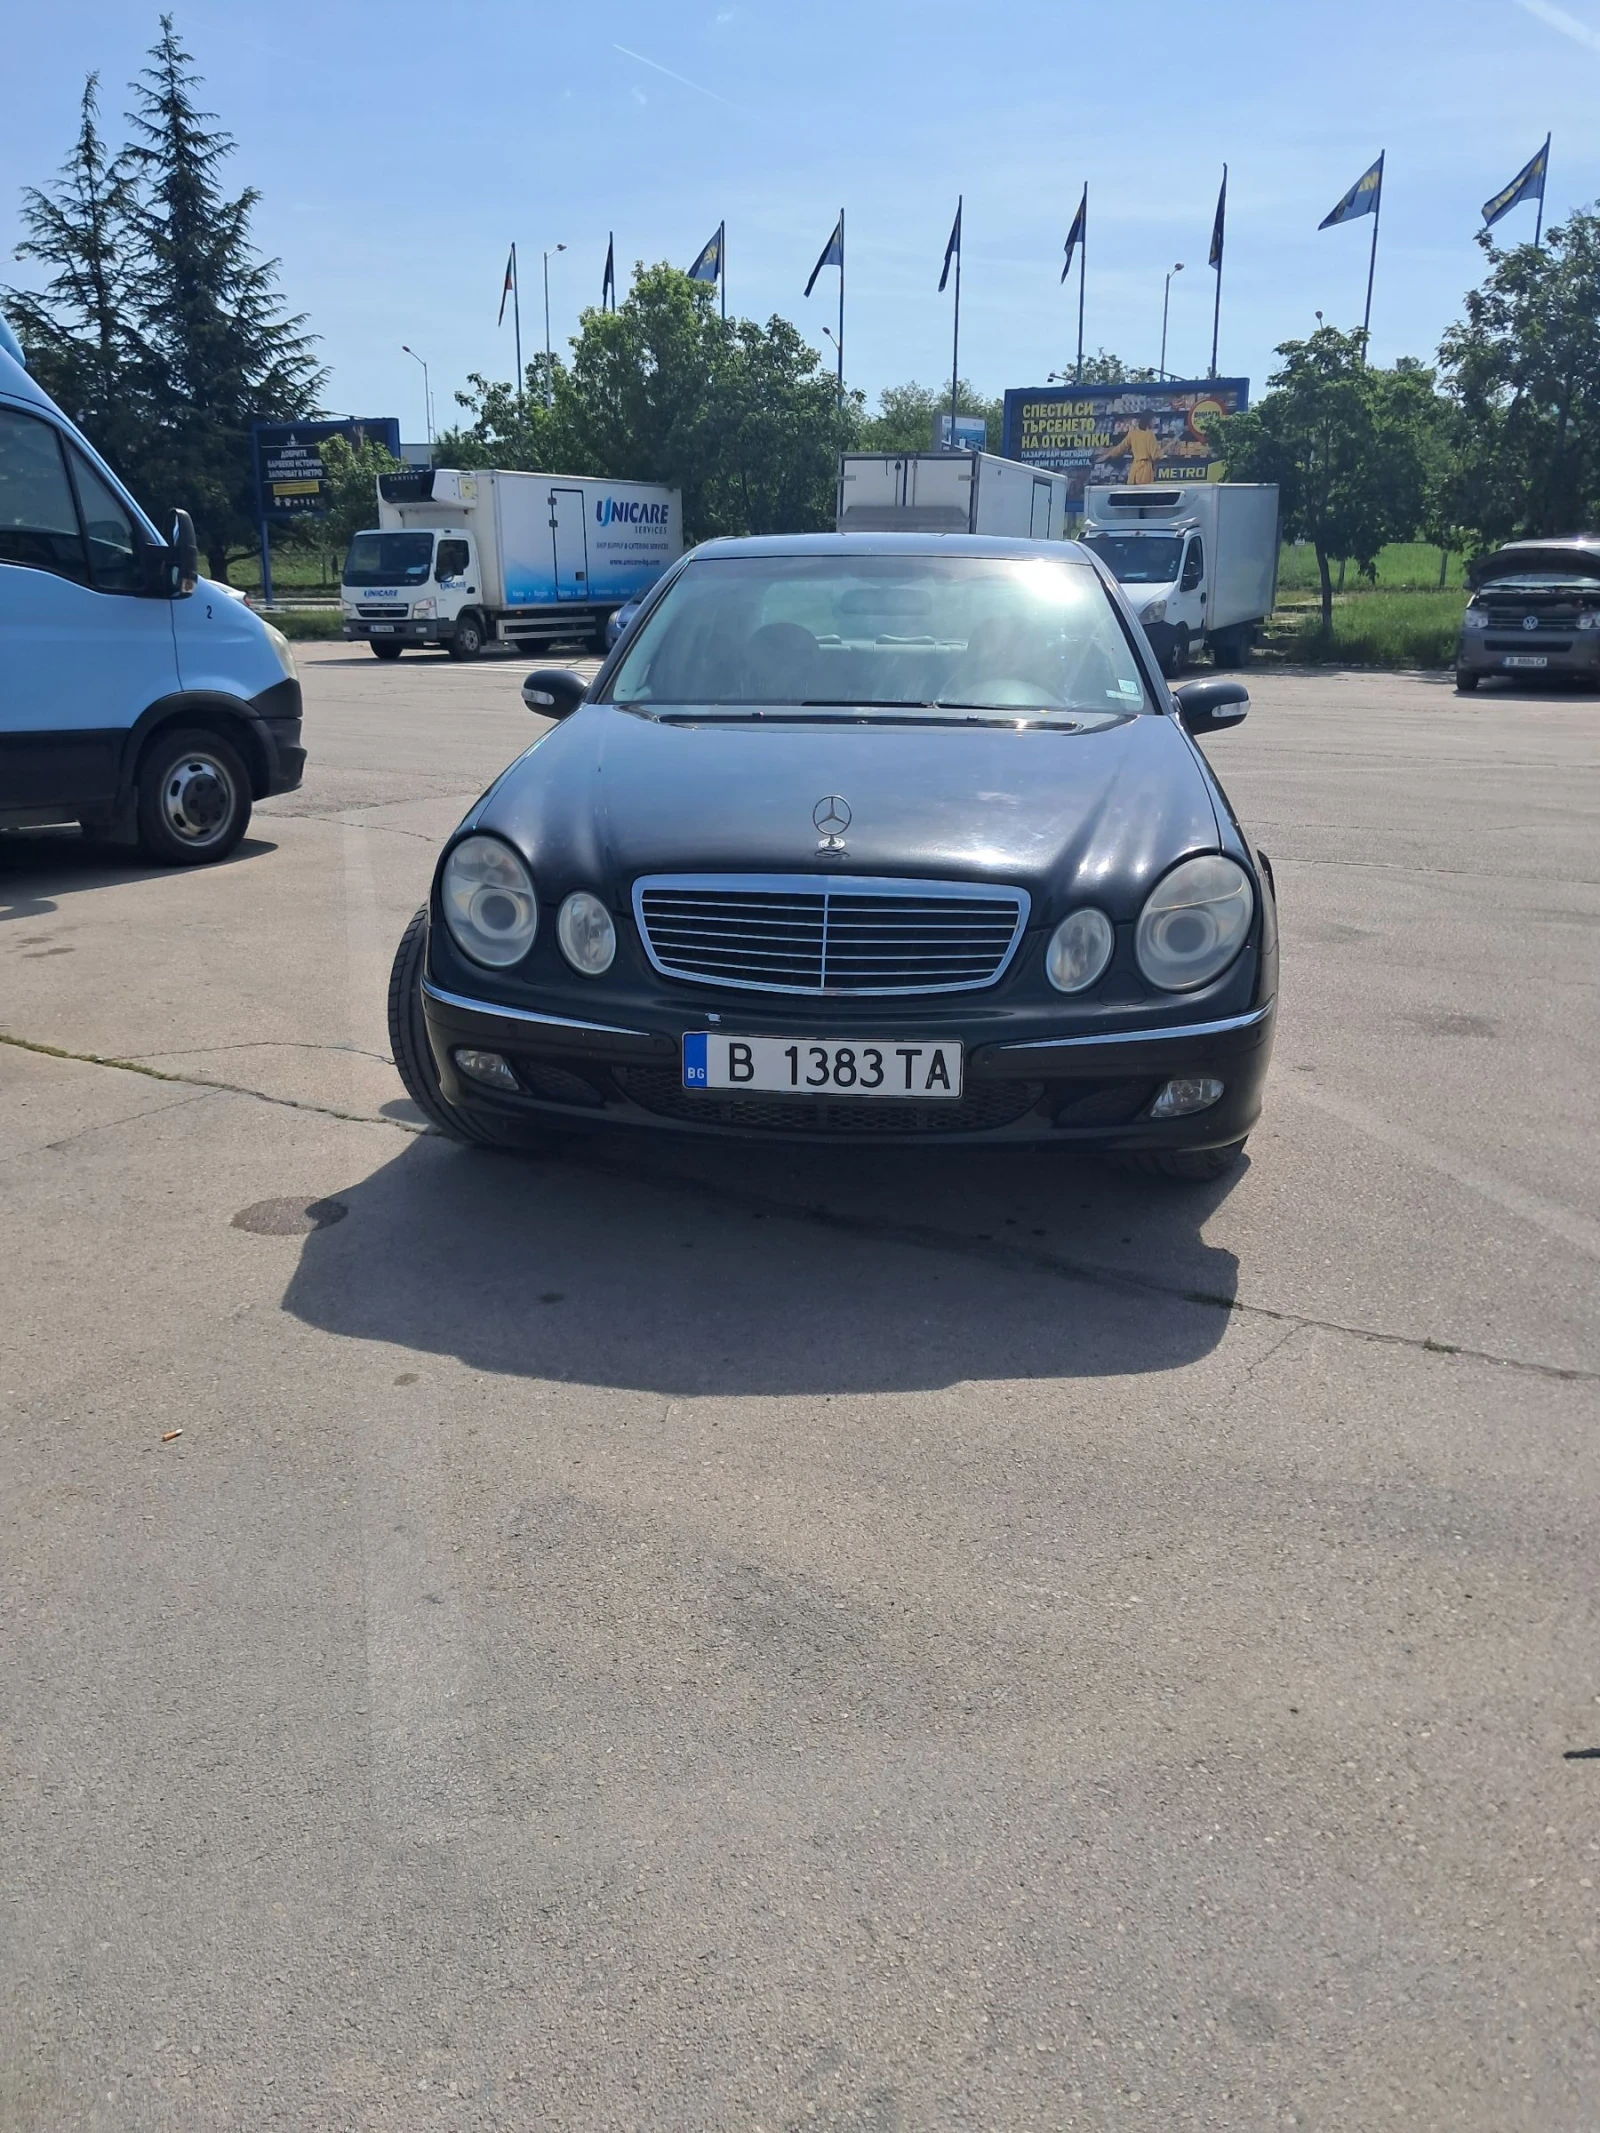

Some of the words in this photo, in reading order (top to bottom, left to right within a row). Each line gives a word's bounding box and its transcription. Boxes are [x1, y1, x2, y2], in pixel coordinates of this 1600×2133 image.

[1022, 402, 1072, 418] СПЕСТИ
[1075, 402, 1094, 416] СИ
[1022, 417, 1096, 433] ТЪРСЕНЕТО
[1021, 435, 1039, 448] НА
[1041, 433, 1113, 448] ОТСТЪПКИ.
[1158, 467, 1206, 478] METRO
[596, 496, 669, 527] UNICARE
[634, 525, 667, 535] SERVICES
[440, 581, 467, 591] UNICARE
[364, 589, 398, 599] UNICARE
[206, 605, 213, 620] 2
[687, 1067, 705, 1079] BG
[729, 1042, 755, 1082] B
[784, 1045, 885, 1088] 1383
[895, 1048, 951, 1090] TA
